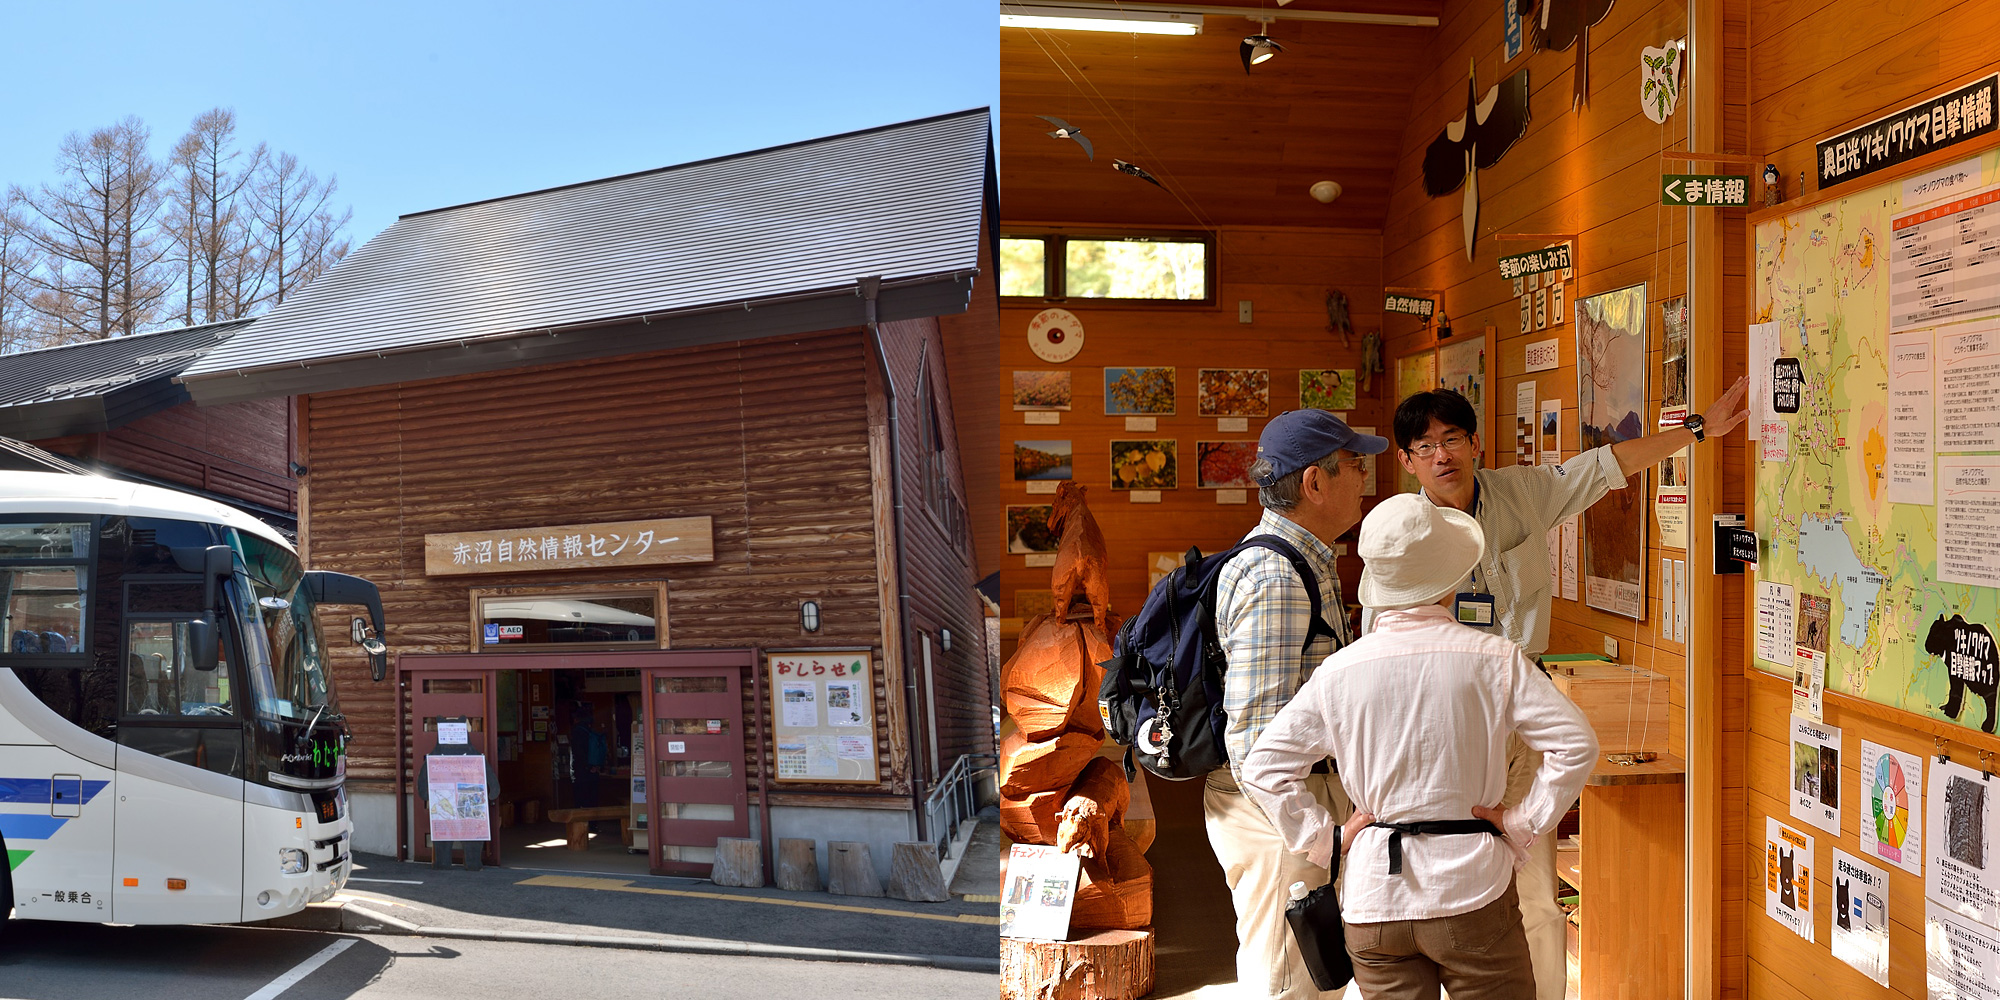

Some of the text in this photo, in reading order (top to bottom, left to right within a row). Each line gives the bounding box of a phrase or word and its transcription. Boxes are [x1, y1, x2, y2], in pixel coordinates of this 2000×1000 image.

[1823, 86, 1992, 180] 奥日光ツキノワグマ目撃情報
[1665, 178, 1745, 204] くま情報
[1499, 248, 1568, 279] 季節の楽しみ方
[1385, 296, 1433, 316] 自然情報
[1521, 284, 1562, 332] 歩き方
[452, 529, 680, 565] 赤沼自然情報センター
[1954, 628, 1991, 661] ツキノワグマ
[777, 660, 847, 677] おしらせ
[1950, 651, 1994, 686] 目撃情報マップ
[281, 753, 312, 763] Hybrid
[42, 890, 92, 904] 一般乗合
